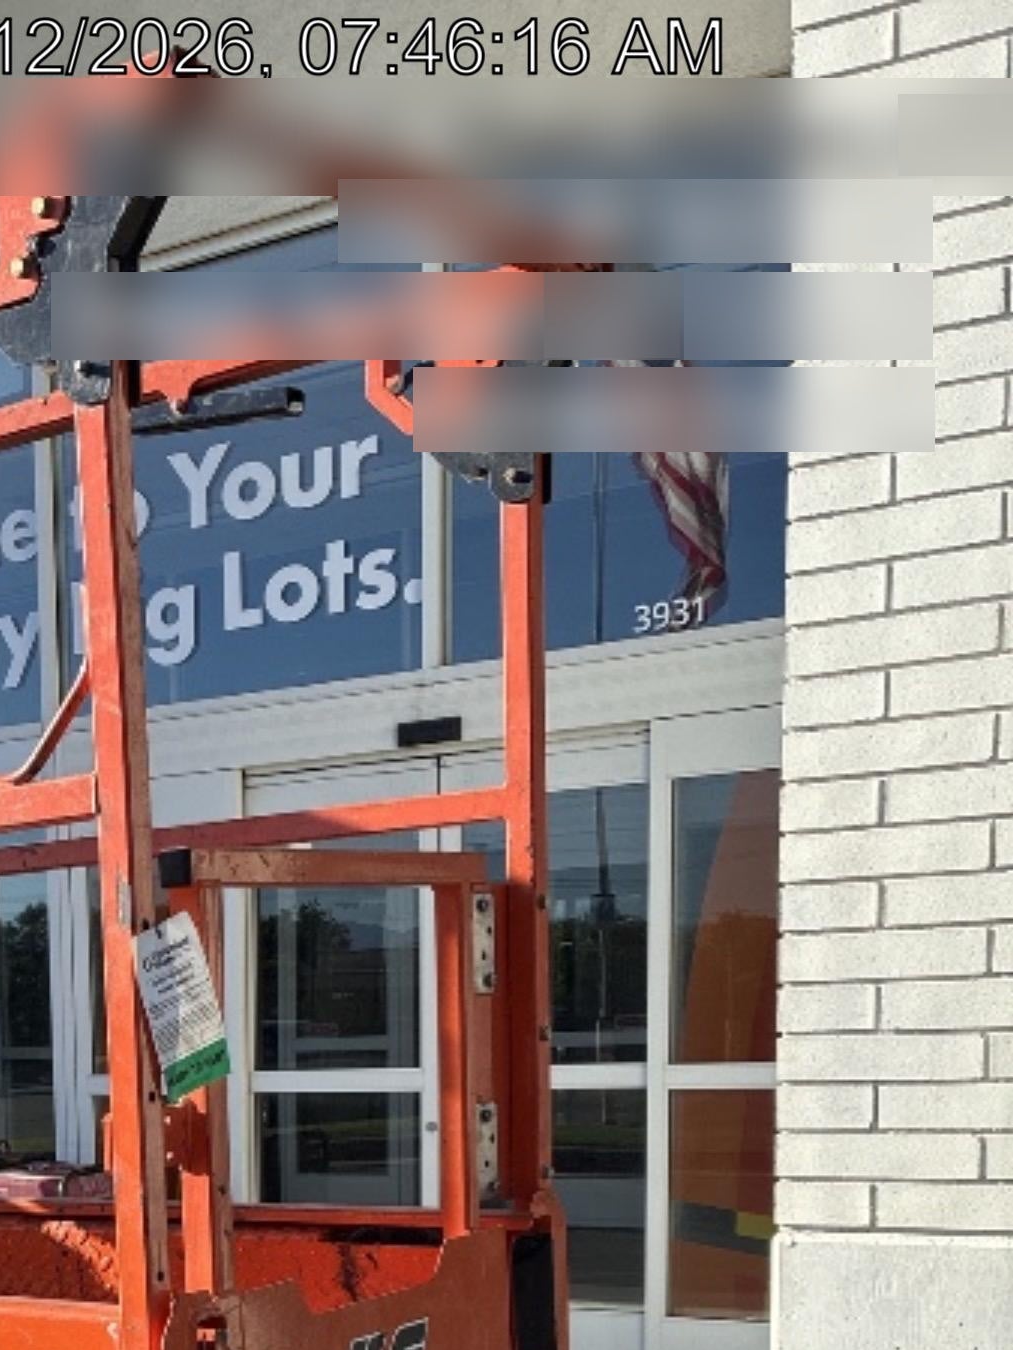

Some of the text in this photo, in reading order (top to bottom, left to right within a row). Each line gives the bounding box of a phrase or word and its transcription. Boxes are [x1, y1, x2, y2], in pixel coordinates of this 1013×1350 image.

[167, 434, 378, 529] Your
[223, 540, 422, 631] Lots.
[632, 596, 704, 633] 3931
